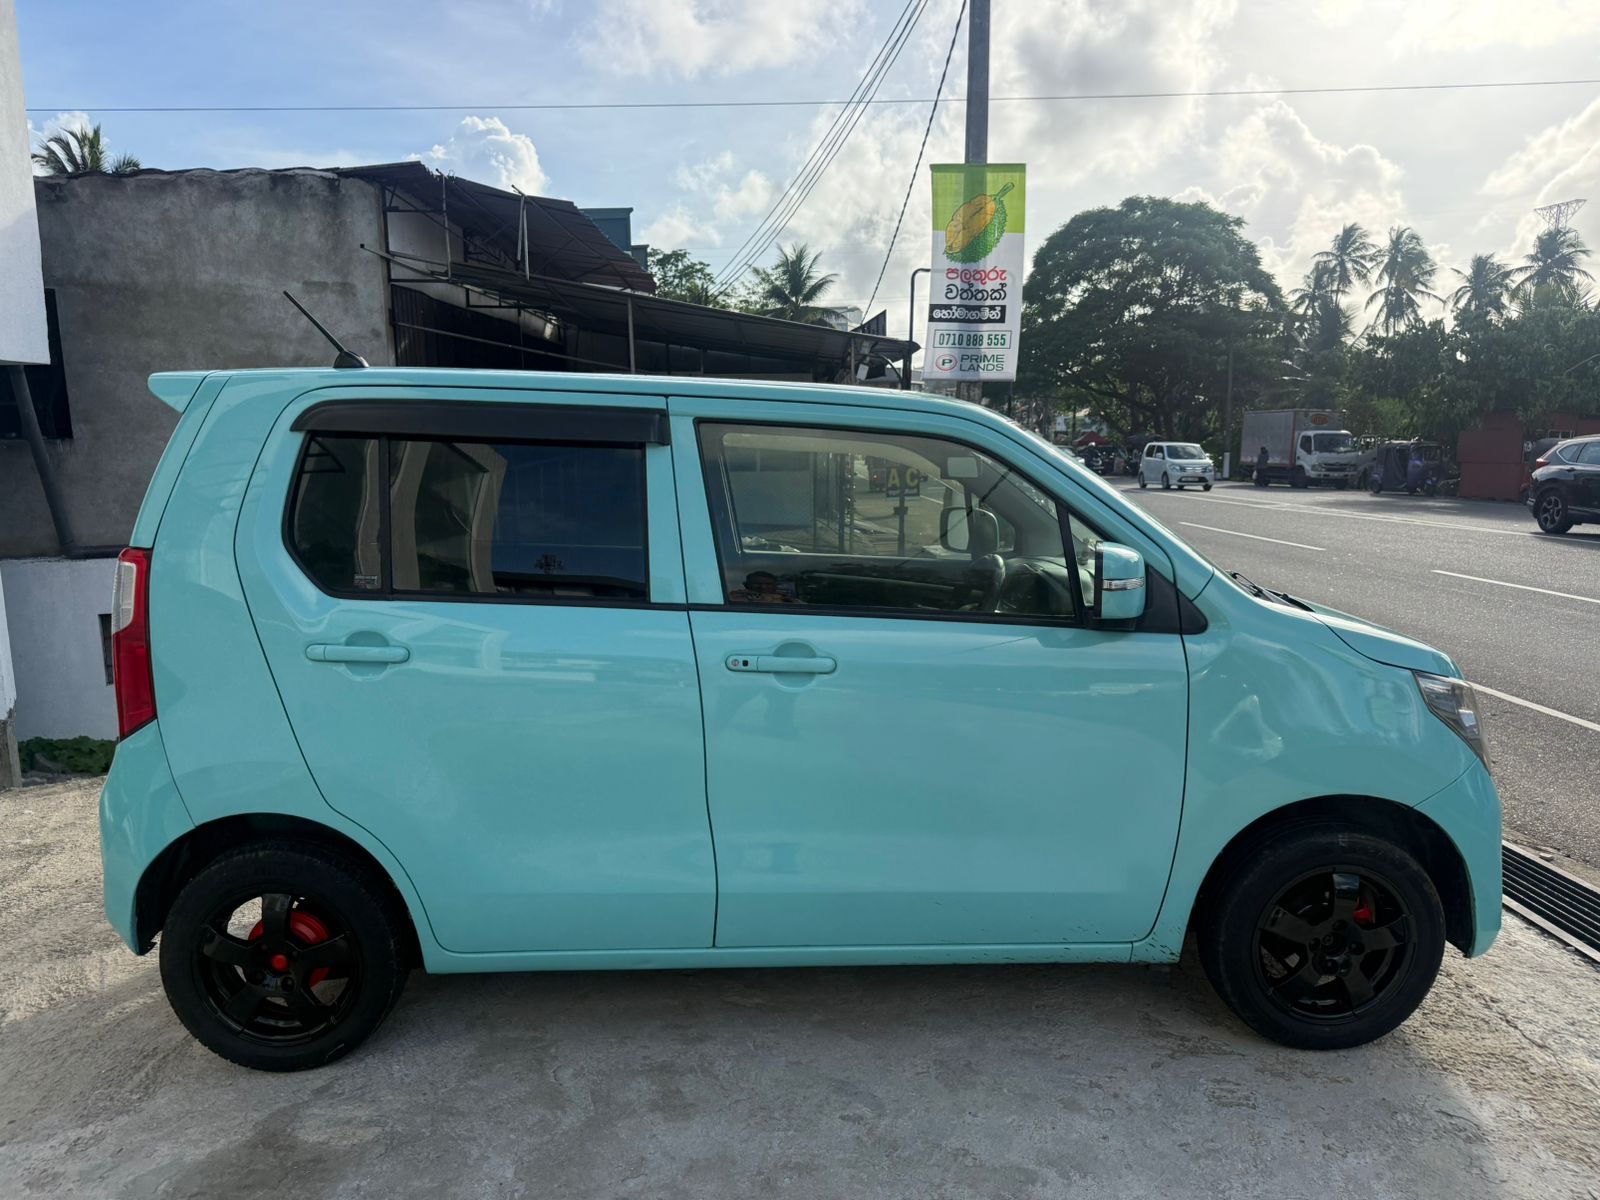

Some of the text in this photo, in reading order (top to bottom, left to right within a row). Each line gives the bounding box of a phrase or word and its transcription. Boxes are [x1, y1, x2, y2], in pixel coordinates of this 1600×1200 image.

[944, 282, 1008, 302] වත්තක්
[938, 334, 1007, 347] 0710 888 555
[960, 354, 1005, 363] PRIME
[959, 363, 1004, 372] LANDS
